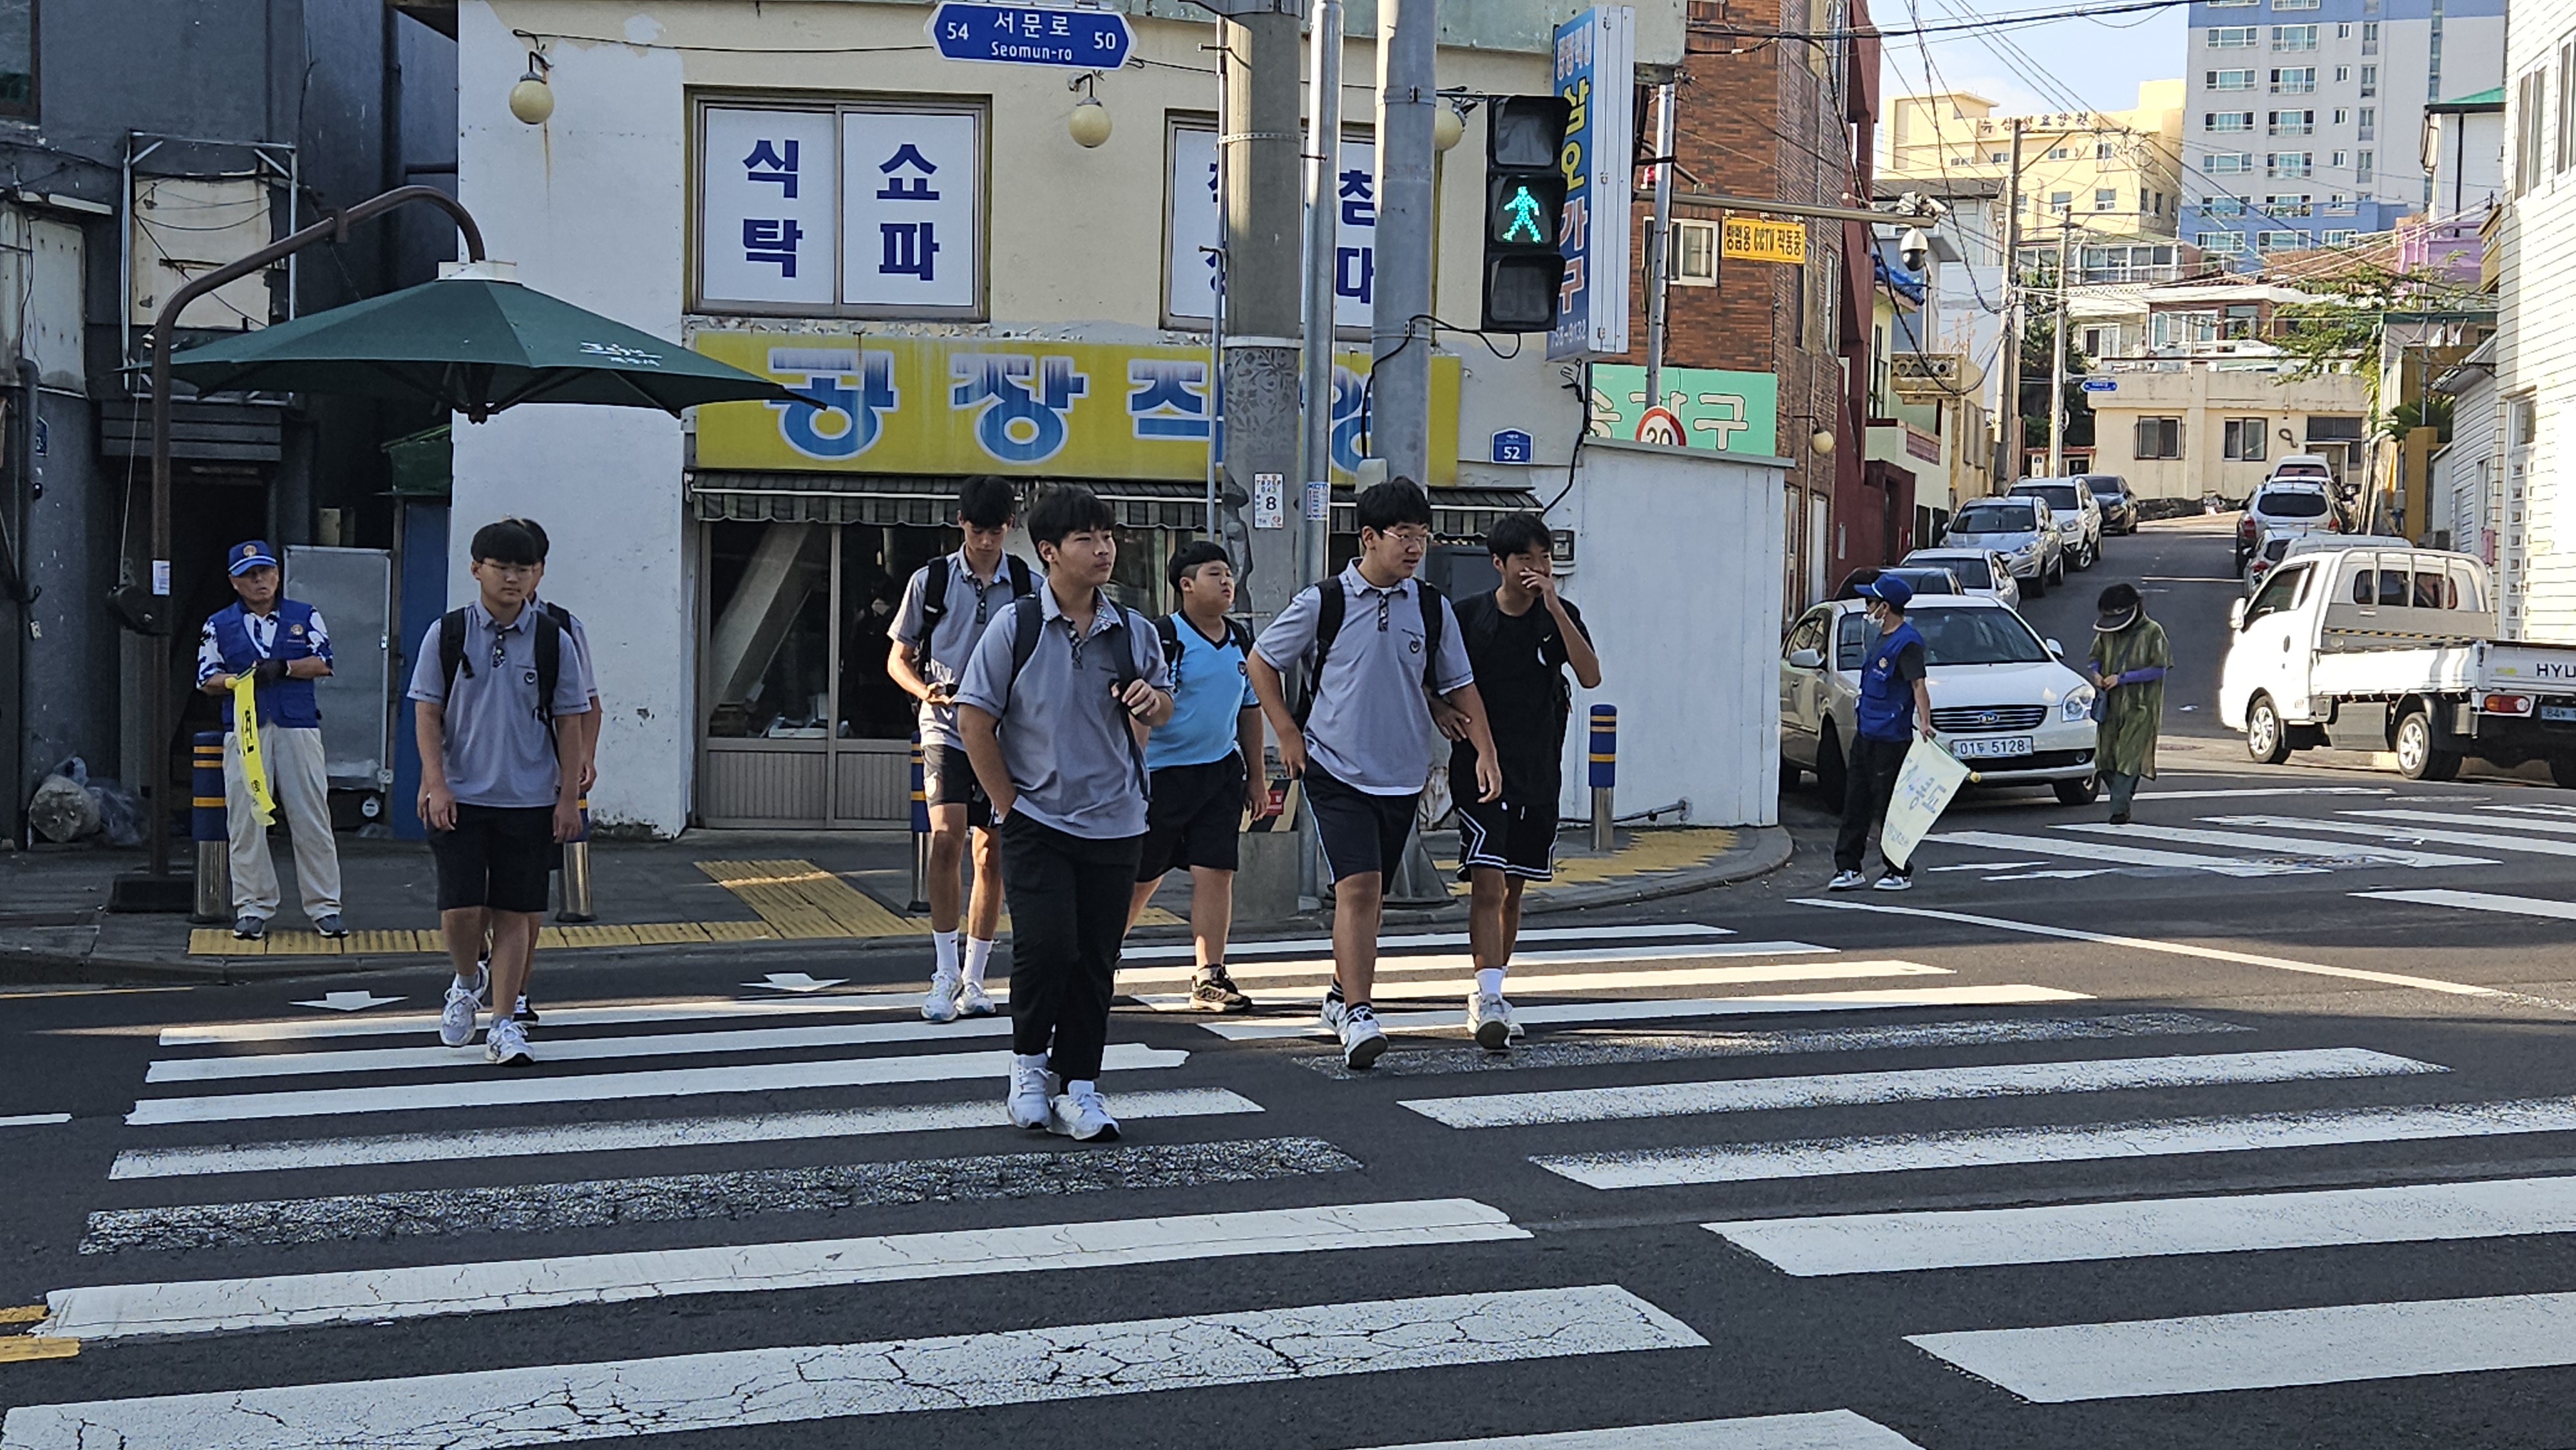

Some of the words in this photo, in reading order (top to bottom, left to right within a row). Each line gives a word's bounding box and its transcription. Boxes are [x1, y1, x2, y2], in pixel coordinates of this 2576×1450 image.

[946, 21, 969, 41] 54
[992, 10, 1072, 39] 서문로
[1093, 32, 1117, 50] 50
[990, 41, 1072, 62] Seomun-ro
[742, 139, 804, 278] 식탁
[876, 143, 940, 281] 쇼파
[1727, 224, 1751, 252] 방범용
[1754, 227, 1776, 252] CCTV
[1777, 229, 1802, 256] 작동중
[1503, 446, 1520, 460] 52
[1265, 496, 1277, 511] 8
[1991, 739, 2025, 753] 5128
